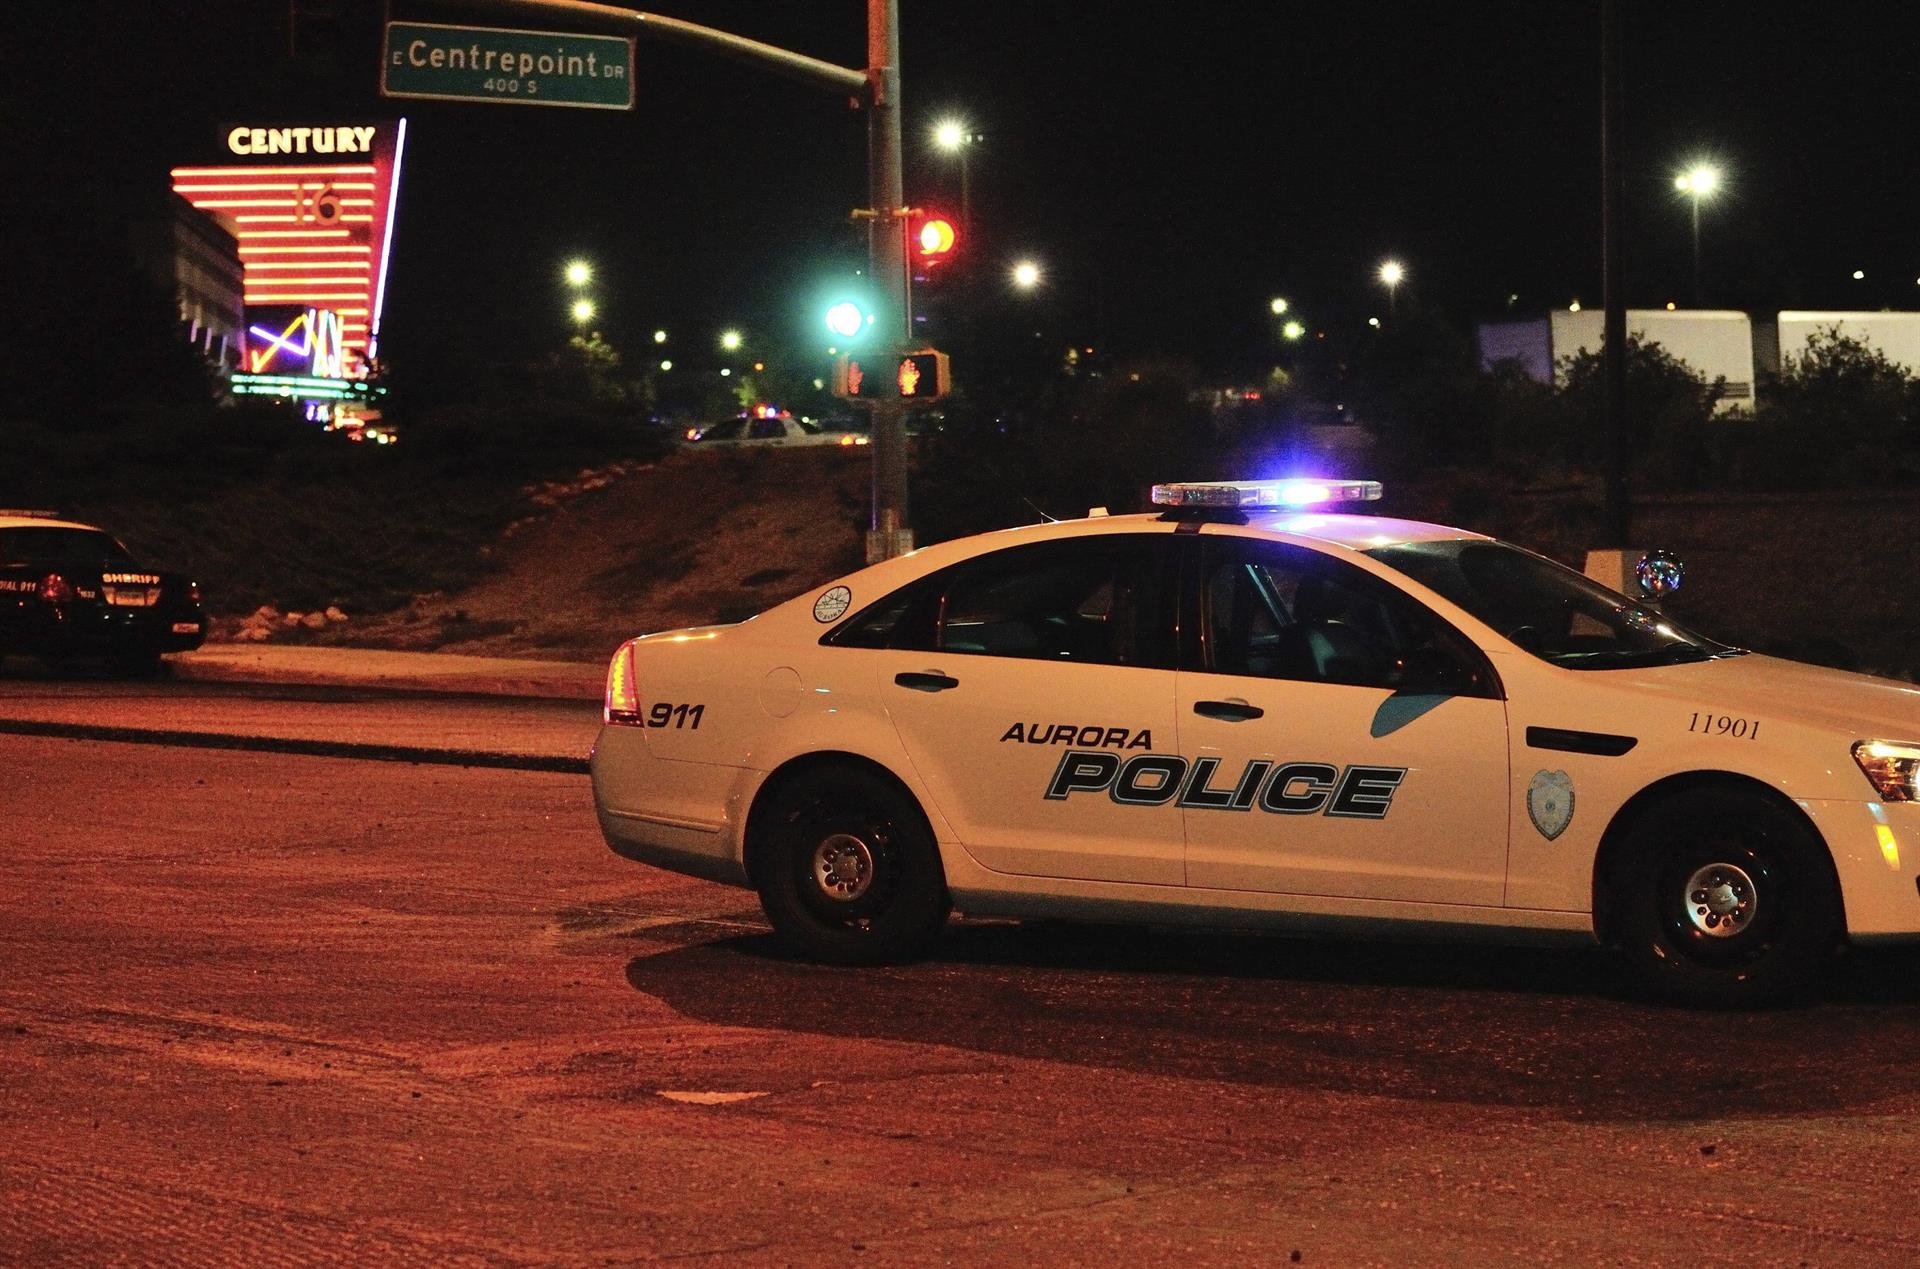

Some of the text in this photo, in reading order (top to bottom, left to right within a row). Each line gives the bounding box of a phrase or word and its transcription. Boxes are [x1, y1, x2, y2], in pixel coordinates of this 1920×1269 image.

[392, 39, 625, 79] E Centrepoint DR
[483, 78, 539, 94] 400 S
[228, 126, 376, 155] CENTURY
[292, 181, 344, 227] 16
[102, 573, 160, 585] SHERIFF
[647, 703, 705, 730] 911
[1688, 712, 1761, 741] 11901
[1000, 722, 1153, 750] AURORA
[1043, 749, 1410, 820] POLICE
